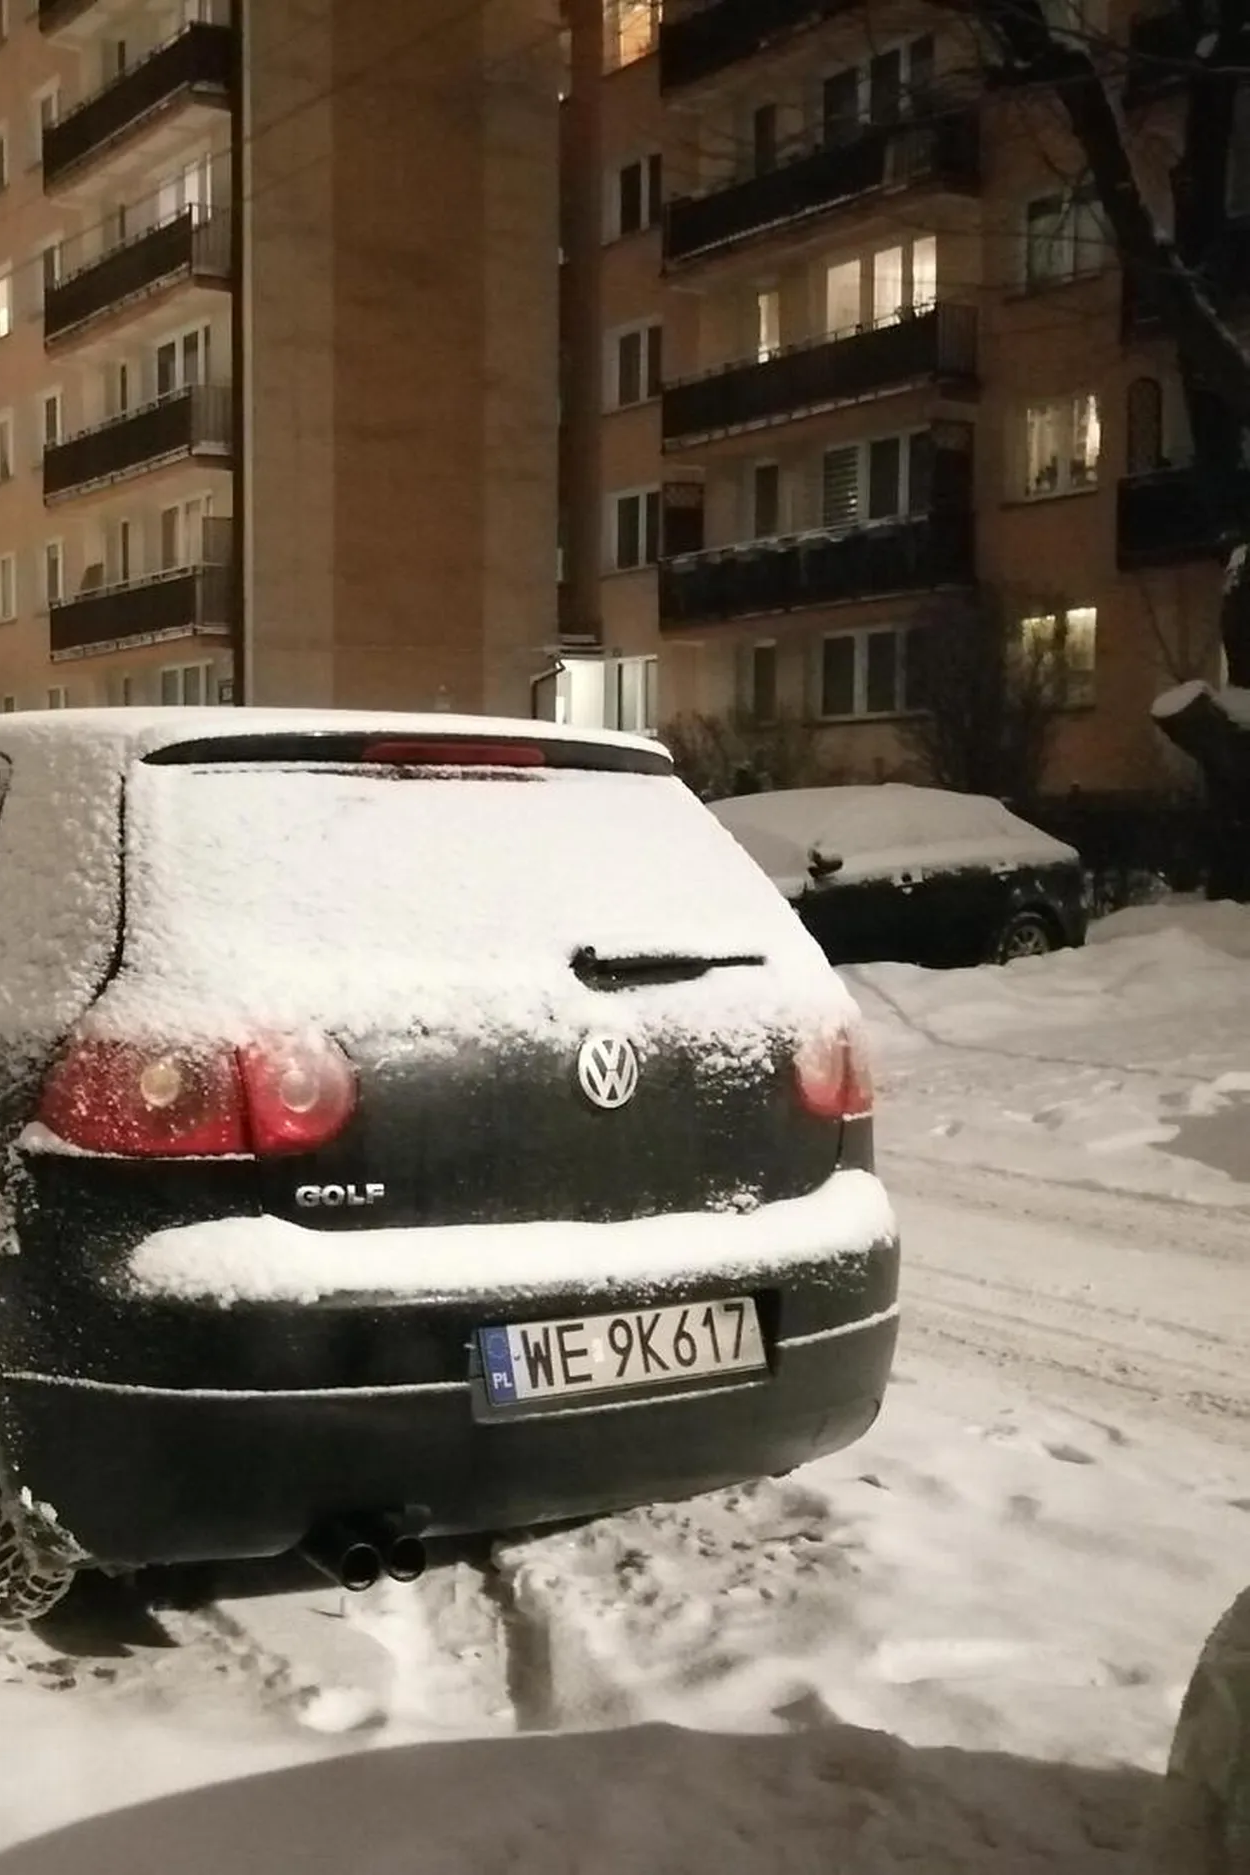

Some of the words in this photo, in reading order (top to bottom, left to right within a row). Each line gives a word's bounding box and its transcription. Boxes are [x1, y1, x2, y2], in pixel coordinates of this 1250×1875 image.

[578, 1034, 639, 1109] VW
[295, 1183, 385, 1208] GOLF
[521, 1323, 593, 1389] WE
[607, 1302, 745, 1378] 9K617
[493, 1372, 513, 1390] PL
